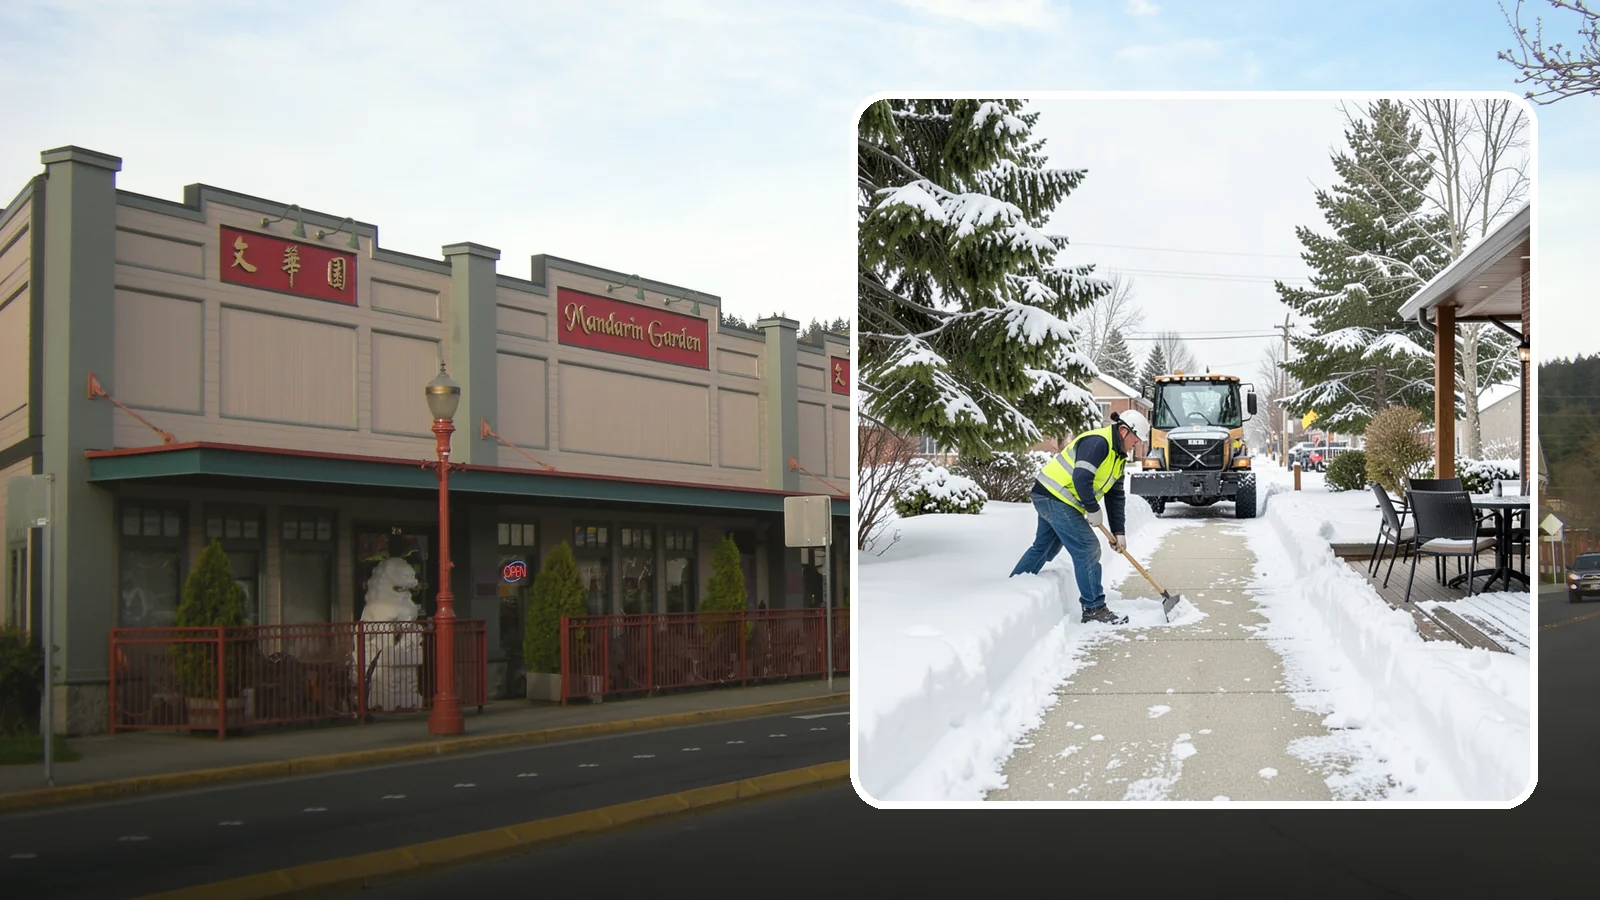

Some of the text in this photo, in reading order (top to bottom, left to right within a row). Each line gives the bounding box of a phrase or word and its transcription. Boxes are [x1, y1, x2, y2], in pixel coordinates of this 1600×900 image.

[230, 235, 346, 291] 文華園
[564, 302, 701, 352] Mandarin Garden
[503, 565, 527, 578] OPEN
